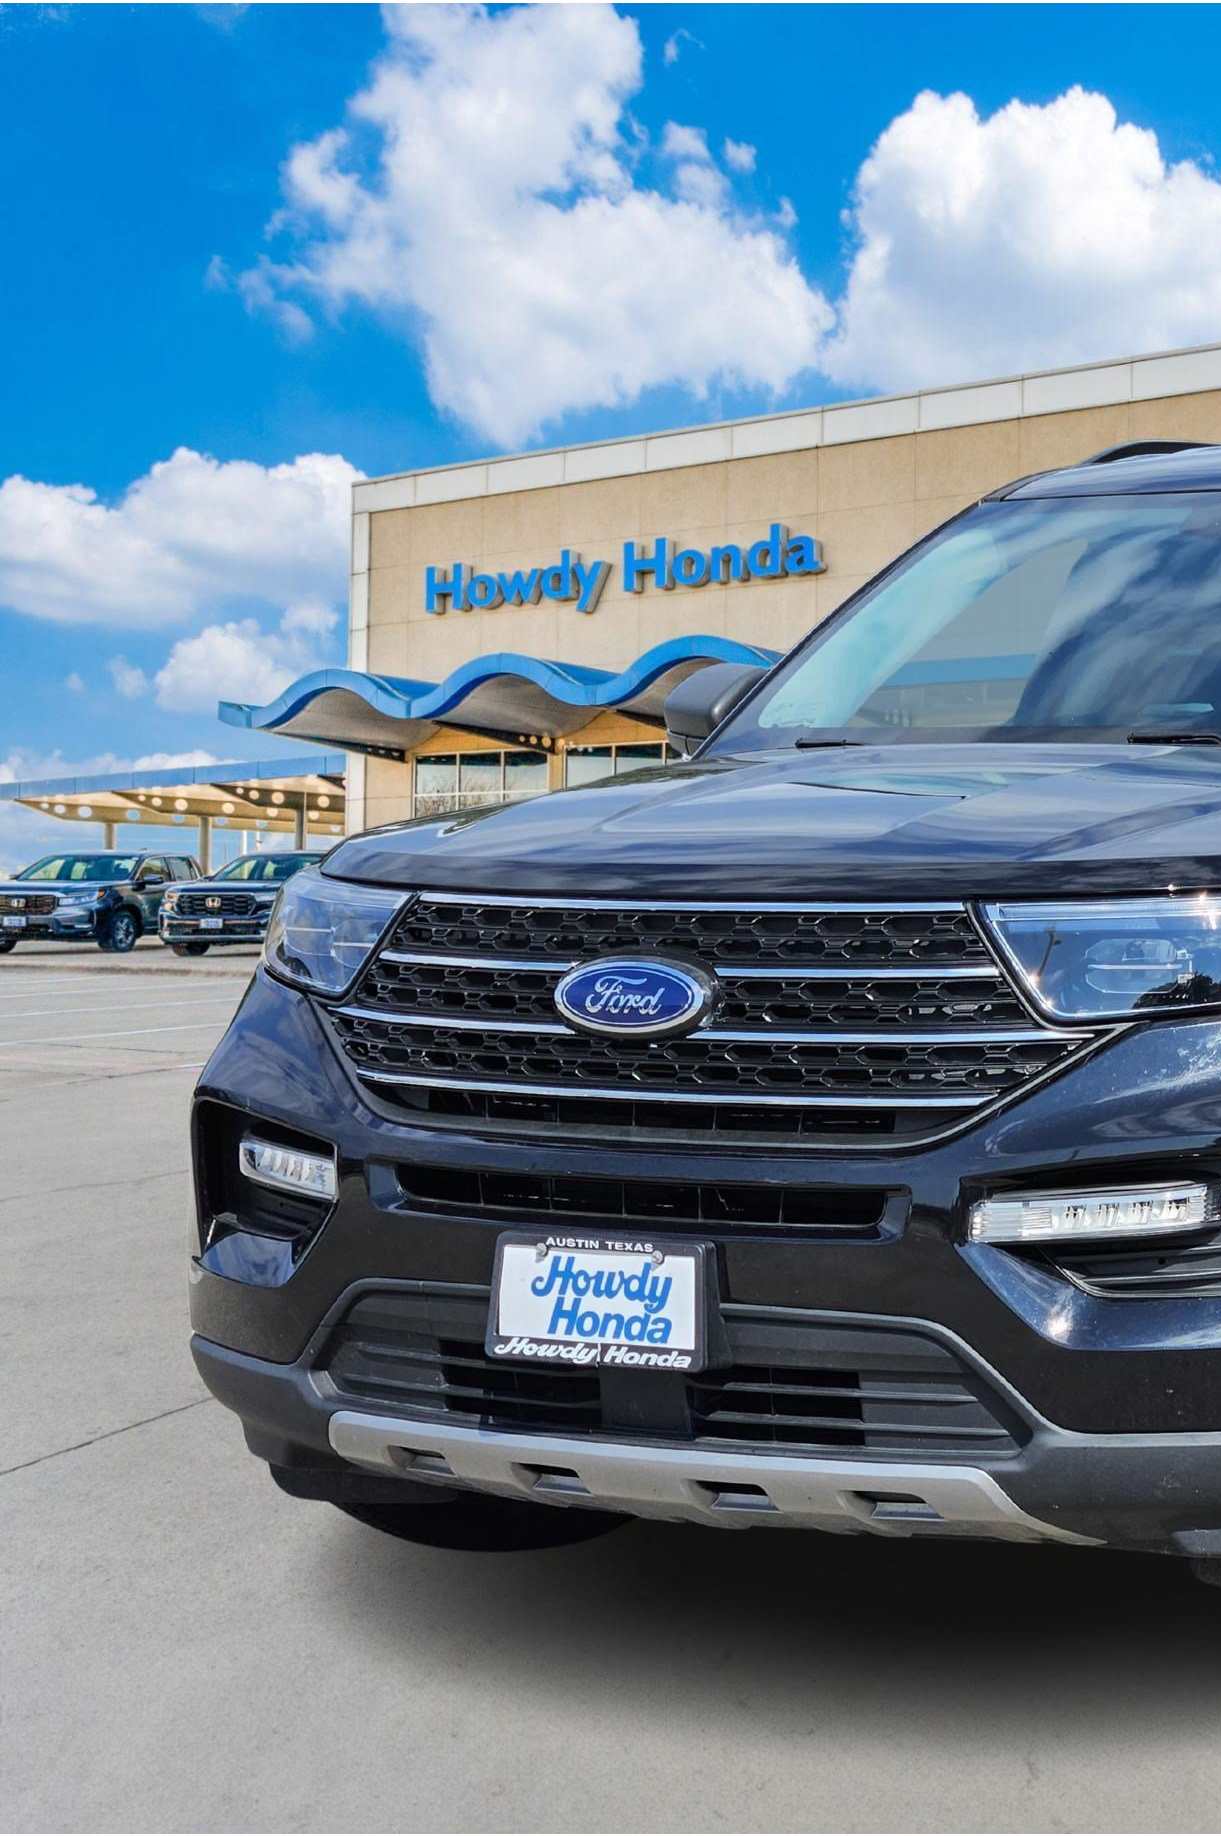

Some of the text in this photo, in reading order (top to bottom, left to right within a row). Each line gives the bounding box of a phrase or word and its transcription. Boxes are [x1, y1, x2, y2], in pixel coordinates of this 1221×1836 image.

[425, 523, 827, 614] Howdy Honda
[585, 975, 665, 1015] Ford
[545, 1237, 654, 1253] AUSTIN TEXAS
[531, 1256, 673, 1313] Howdy
[547, 1296, 673, 1344] Honda
[494, 1337, 692, 1369] Howdy Honda
